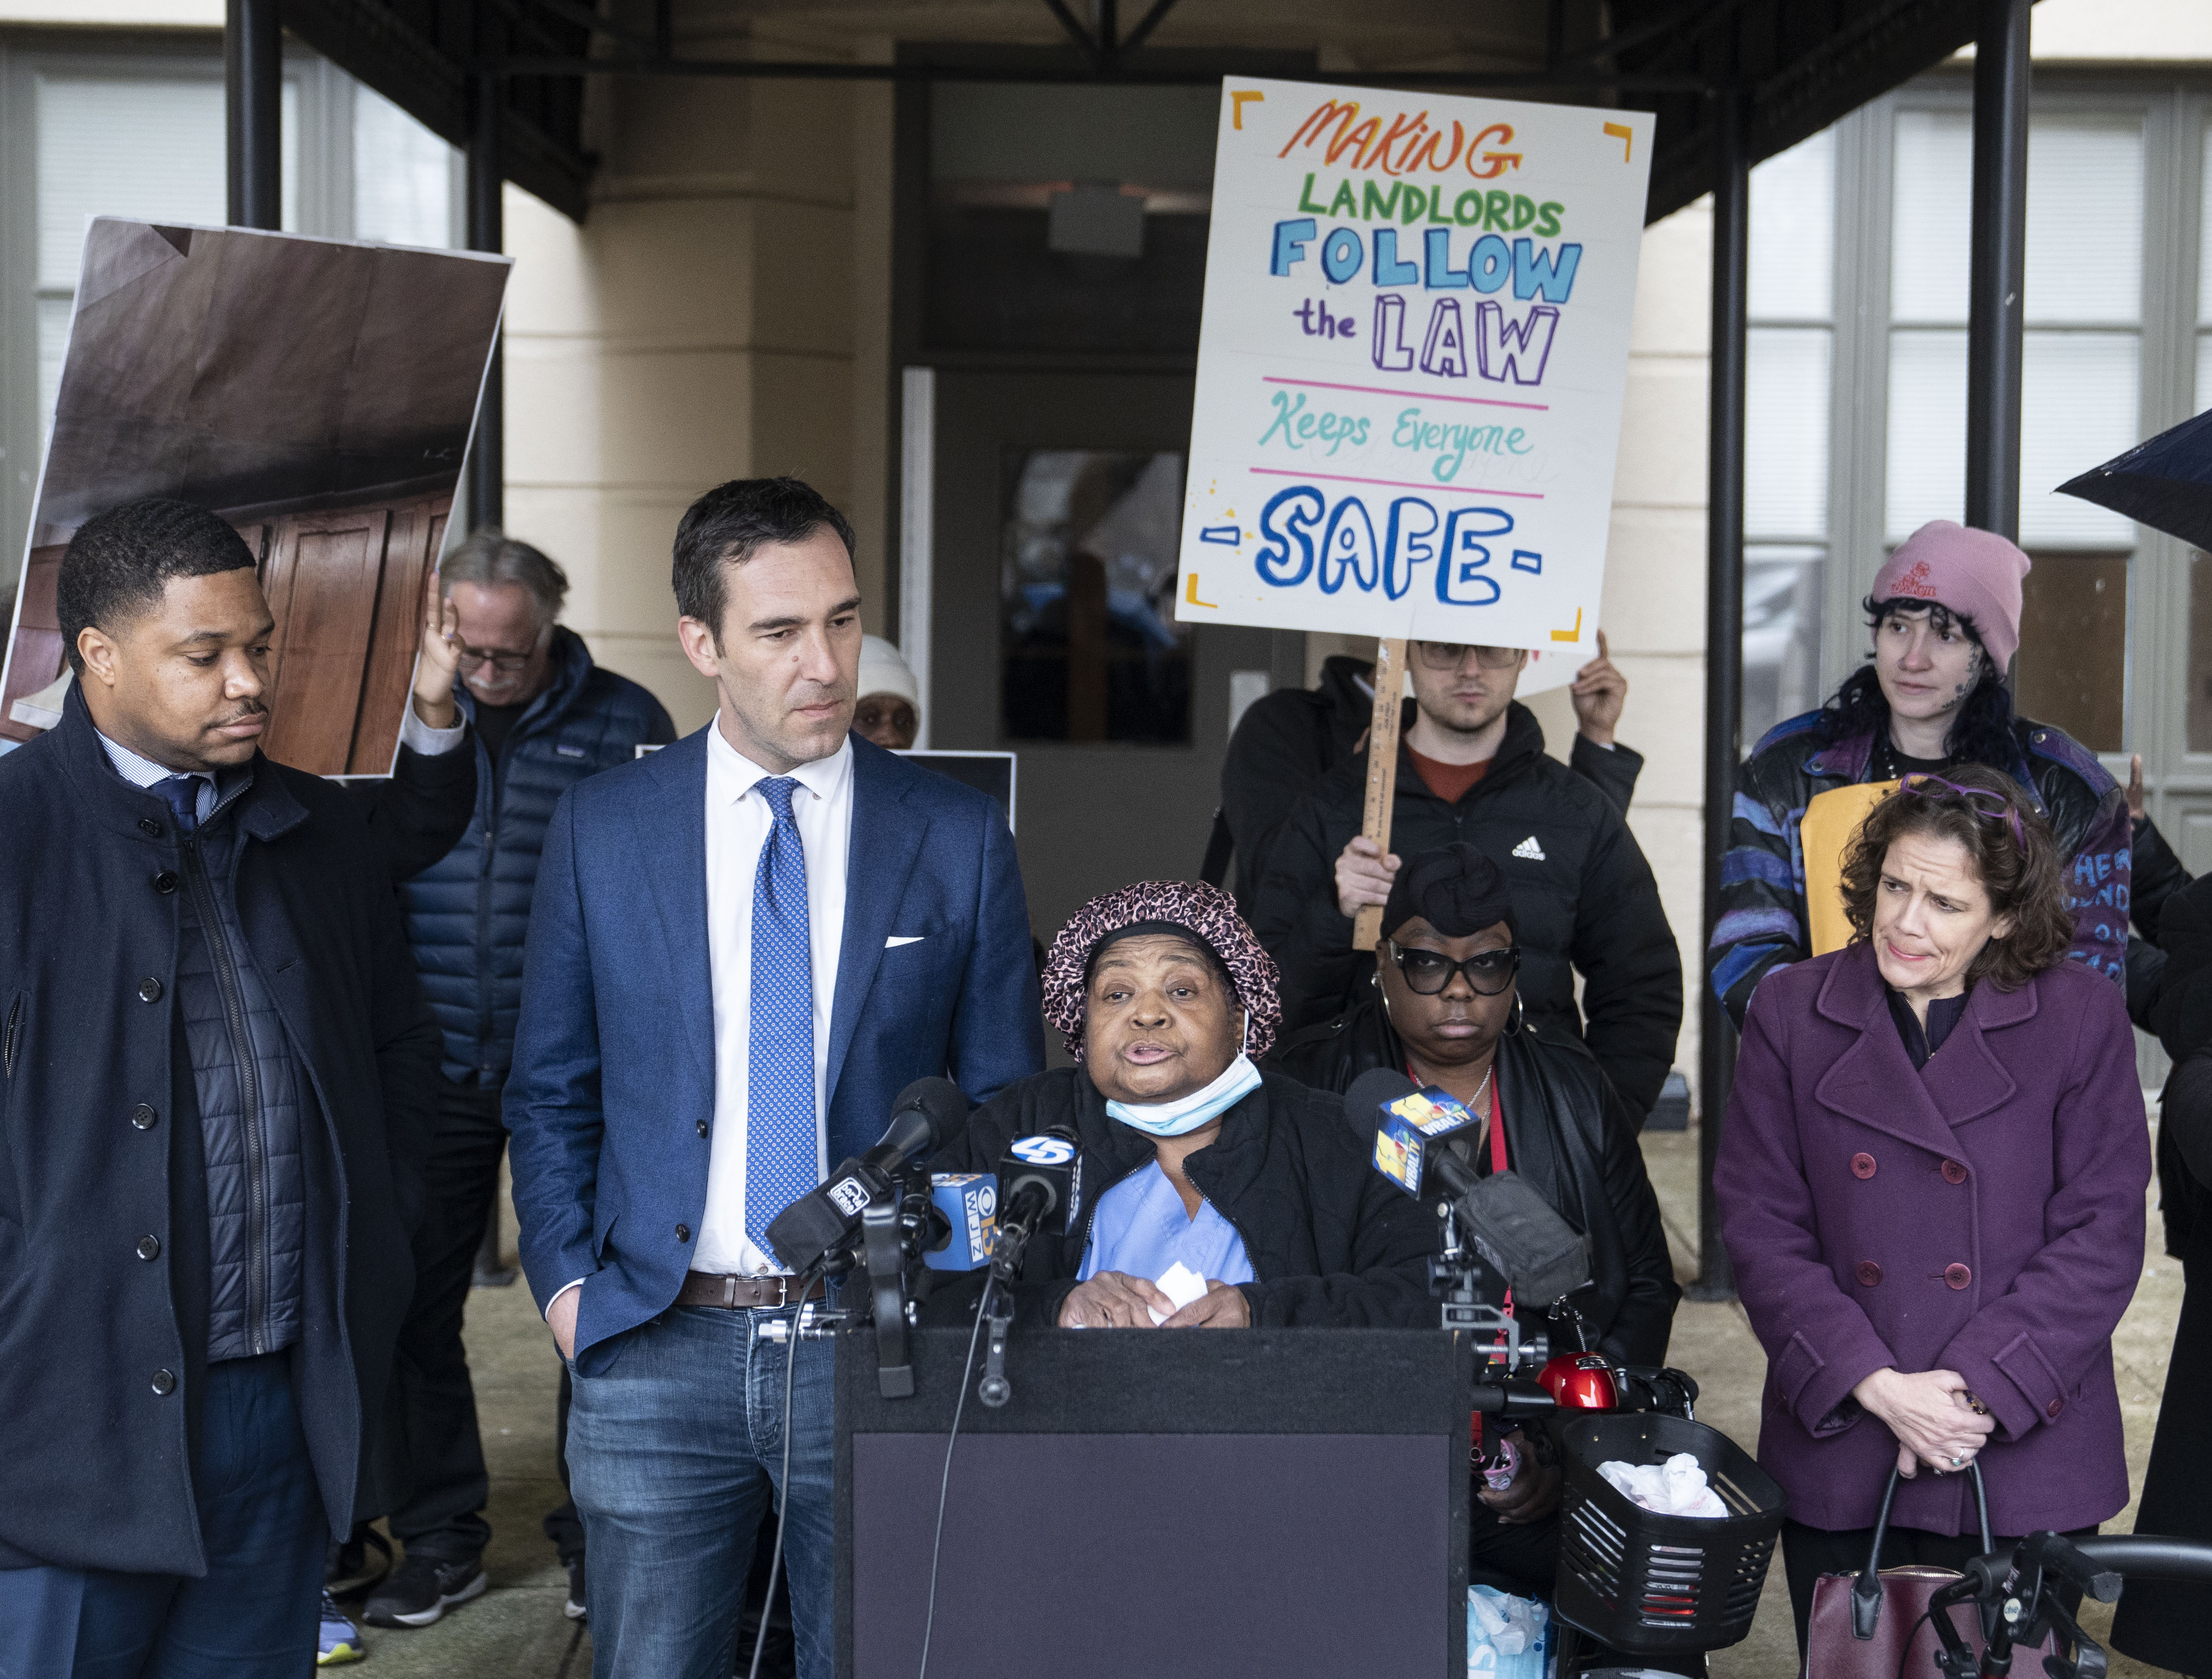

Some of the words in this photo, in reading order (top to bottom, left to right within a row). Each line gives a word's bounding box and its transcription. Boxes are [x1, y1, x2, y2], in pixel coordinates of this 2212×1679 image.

[1298, 172, 1565, 238] LANDLORDS
[1270, 218, 1582, 304] FOLLOW
[1293, 298, 1356, 339] the
[1371, 294, 1559, 385] LAW
[1258, 391, 1371, 456] Keeps
[1393, 409, 1534, 483] Everyone
[1512, 848, 1546, 861] adidas
[833, 1189, 855, 1212] brace
[840, 1183, 864, 1208] porta
[966, 1191, 982, 1256] WJZ
